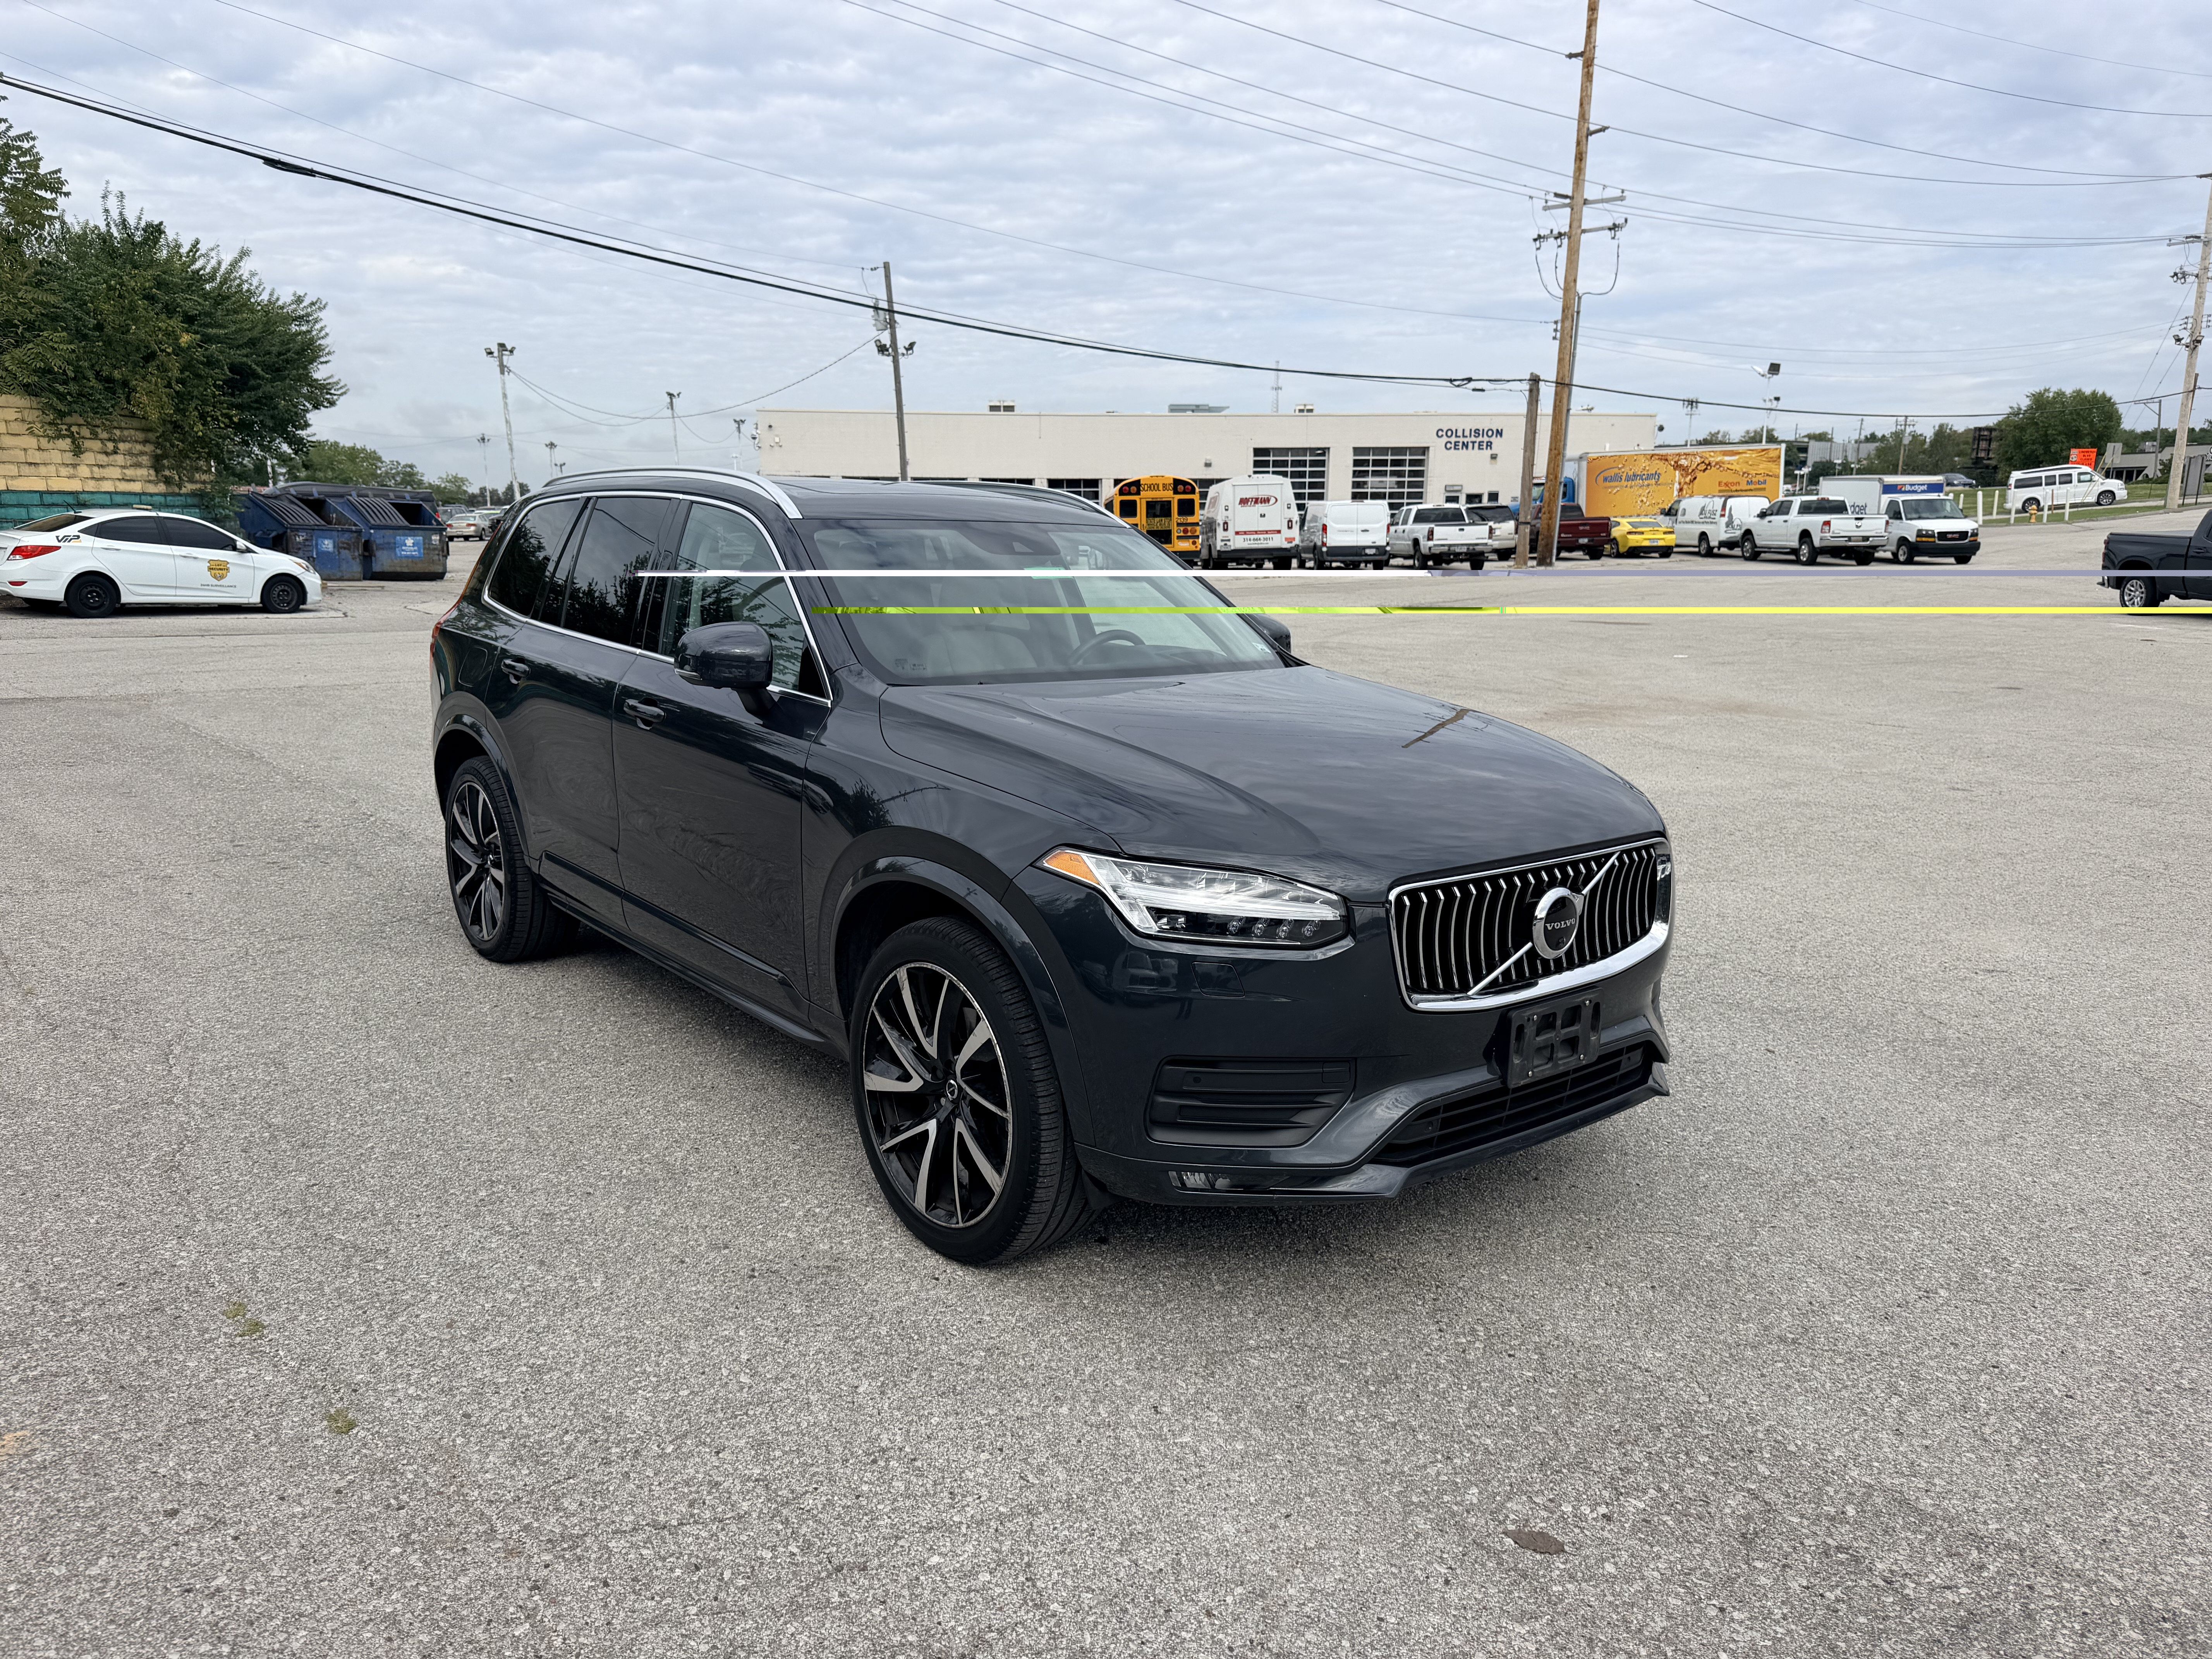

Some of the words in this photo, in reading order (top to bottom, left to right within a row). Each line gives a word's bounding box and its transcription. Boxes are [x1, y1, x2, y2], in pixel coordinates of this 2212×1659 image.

[1436, 428, 1503, 438] COLLISION
[1444, 441, 1493, 450] CENTER
[1603, 472, 1623, 483] wallis
[1625, 471, 1661, 482] lubricants
[1140, 483, 1161, 491] SCHOOL
[1162, 483, 1173, 491] BUS
[1718, 481, 1740, 489] Exxon
[1849, 502, 1867, 515] dget
[1546, 918, 1575, 930] VOLVO
